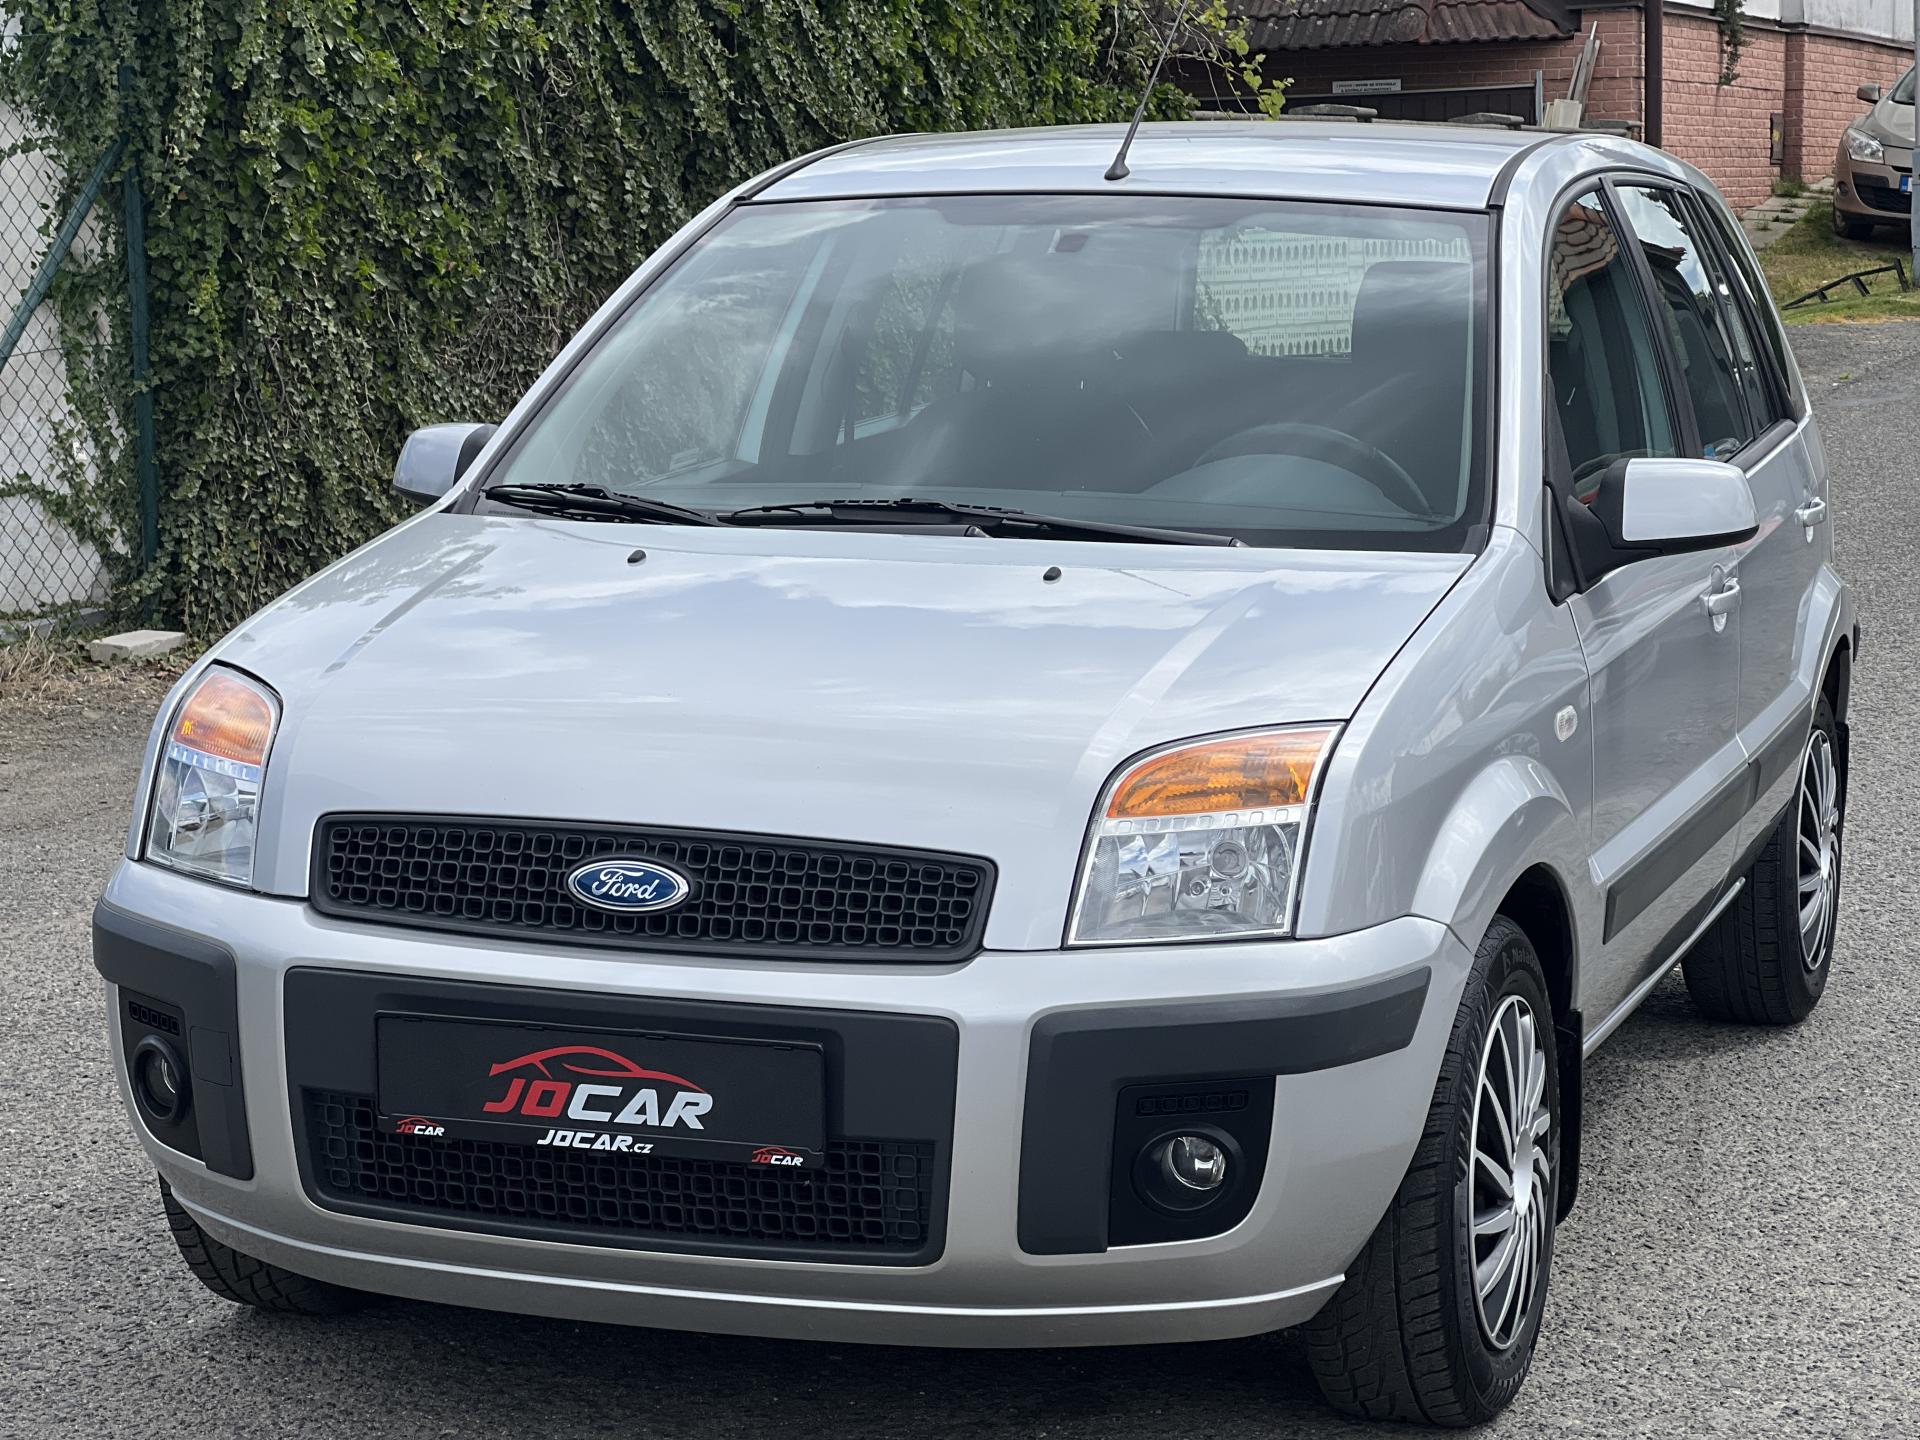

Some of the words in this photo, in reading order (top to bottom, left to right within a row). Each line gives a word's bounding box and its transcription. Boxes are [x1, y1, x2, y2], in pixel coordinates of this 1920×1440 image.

[591, 868, 660, 899] Ford
[482, 1078, 713, 1130] JOCAR
[396, 1124, 445, 1136] JOCAR
[751, 1154, 804, 1167] JOCAR
